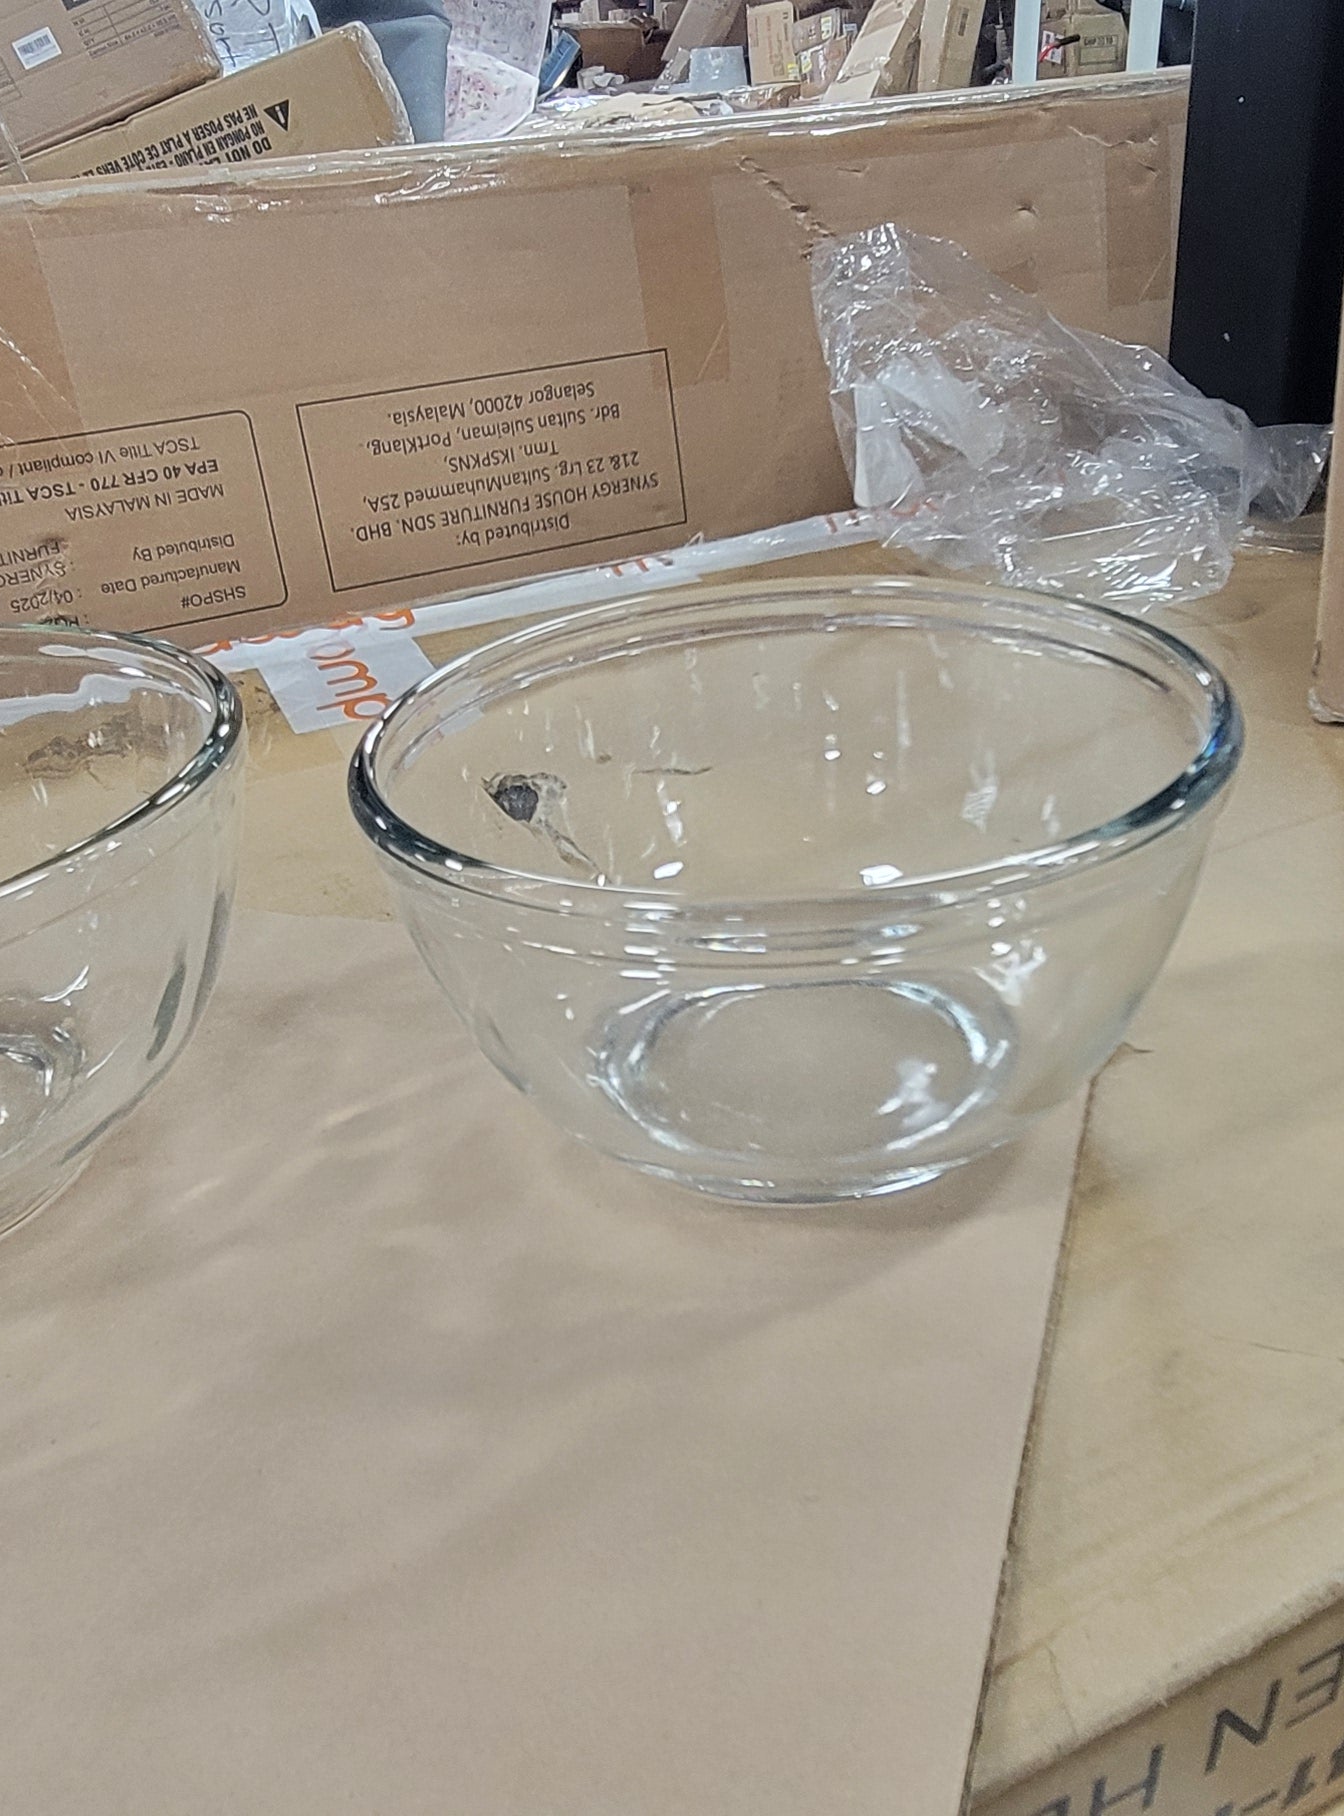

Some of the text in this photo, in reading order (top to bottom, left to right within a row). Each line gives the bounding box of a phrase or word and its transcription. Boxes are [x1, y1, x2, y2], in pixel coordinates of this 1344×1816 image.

[224, 108, 244, 125] PAS
[243, 103, 259, 119] NE
[191, 119, 225, 140] POSER
[251, 120, 266, 136] NO
[159, 134, 184, 150] PLAT
[216, 126, 253, 151] PONGAN
[249, 137, 272, 155] DO
[148, 145, 163, 160] CE
[174, 147, 202, 168] PLANO
[200, 141, 217, 157] EN
[225, 147, 252, 164] NOT
[387, 381, 595, 426] Selangor 42000, Malaysia.
[366, 403, 620, 456] Bdr. Sultan Suleiman, PortKlang,
[119, 443, 153, 459] Title
[154, 436, 201, 454] TSCA
[17, 451, 94, 475] compliant
[98, 447, 117, 464] VI
[443, 440, 560, 473] Tmn. IKSPKNS,
[162, 465, 182, 480] 40
[187, 458, 219, 475] EPA
[555, 459, 583, 477] Lrg.
[586, 457, 605, 473] 23
[89, 475, 118, 493] 770
[123, 468, 159, 486] CFR
[26, 480, 77, 501] TSCA
[64, 482, 225, 522] MADE IN MALAYSIA
[350, 471, 660, 542] SYNERGY HOUSE FURNITURE SDN. BHD.
[362, 494, 400, 514] 25A,
[455, 513, 570, 546] Distributed by:
[132, 533, 236, 563] Distributed By
[100, 559, 242, 595] Manufactured Date
